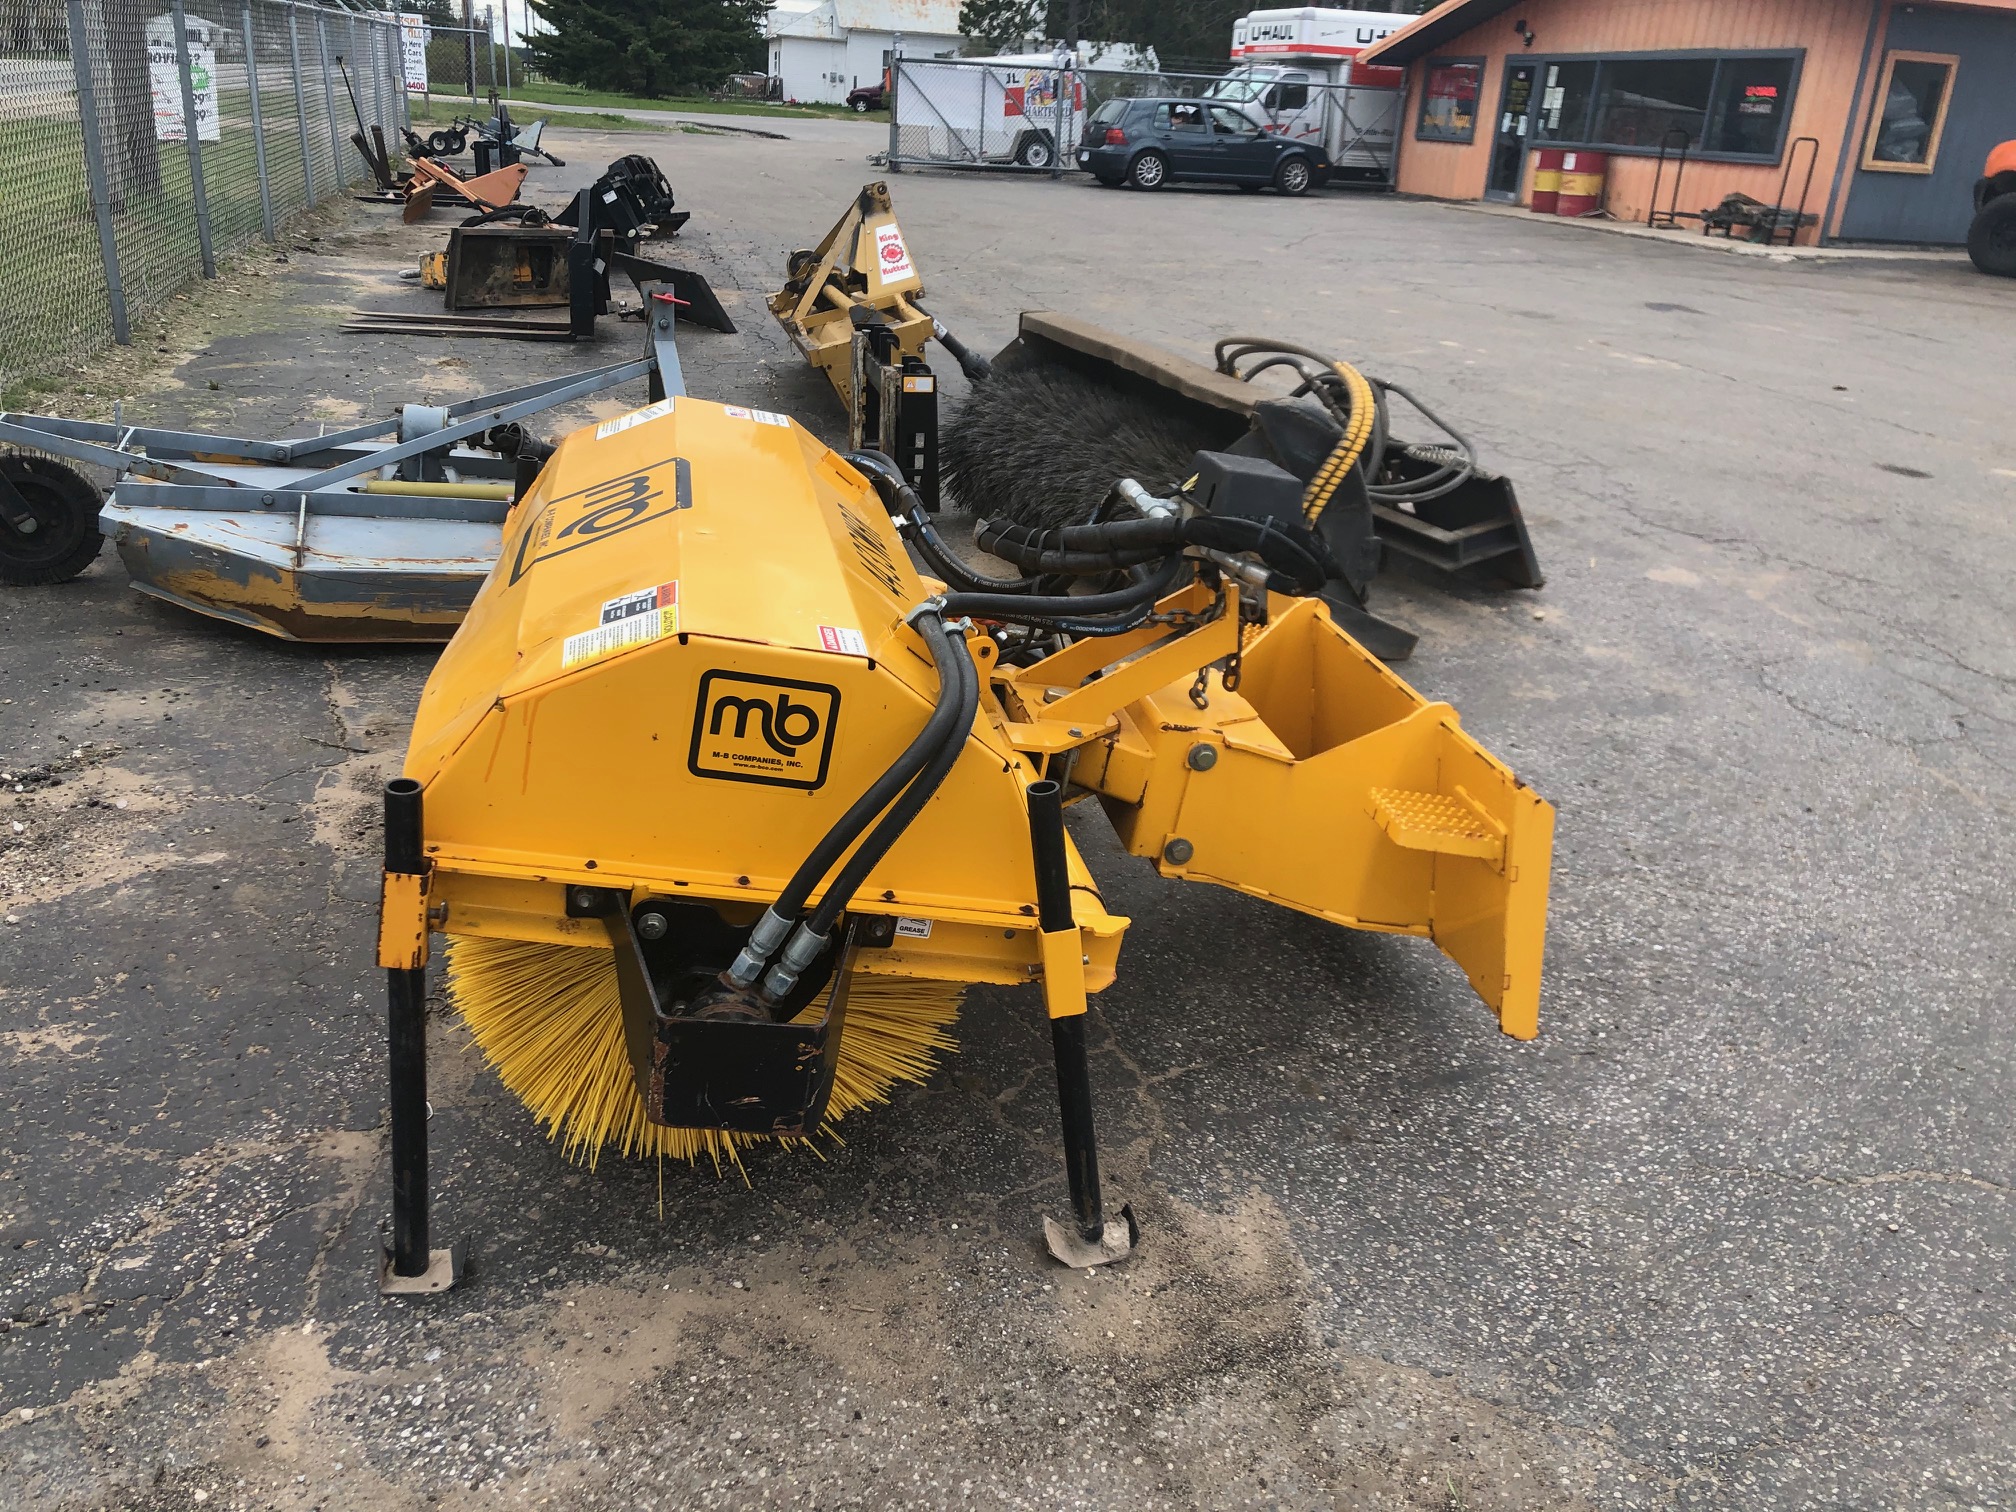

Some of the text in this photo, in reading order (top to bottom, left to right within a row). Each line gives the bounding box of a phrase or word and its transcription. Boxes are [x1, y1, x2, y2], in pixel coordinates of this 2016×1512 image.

[1025, 106, 1072, 117] HARTFOD
[879, 233, 899, 242] King
[882, 263, 910, 275] Kutter
[712, 751, 804, 768] M-B COMPANIES, INC.
[899, 925, 926, 934] GREASE
